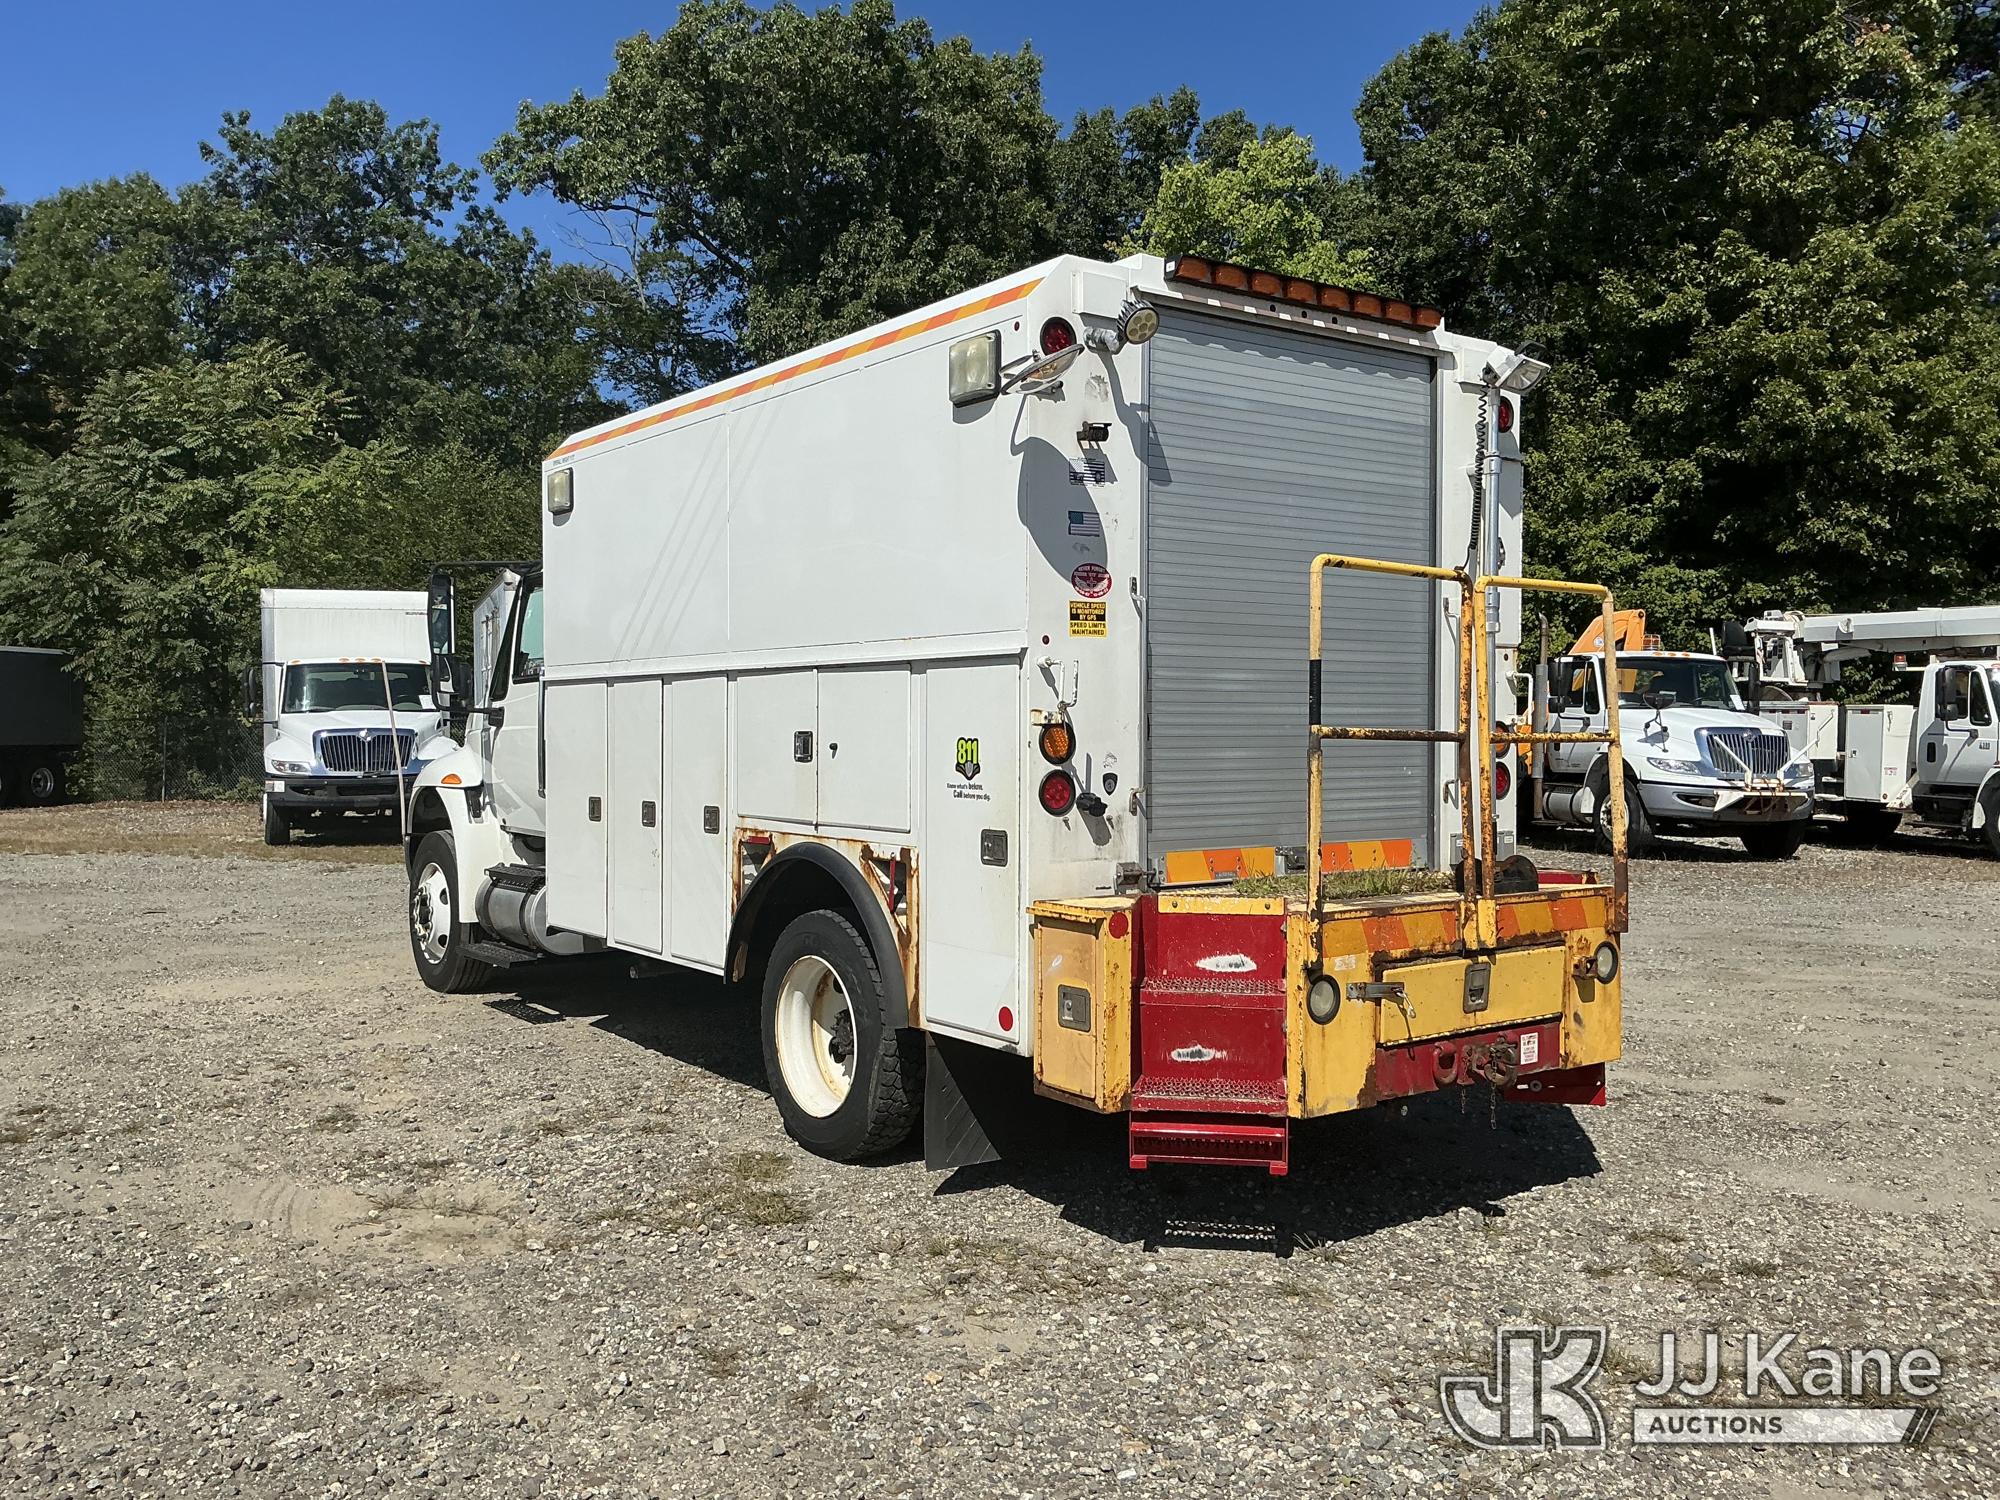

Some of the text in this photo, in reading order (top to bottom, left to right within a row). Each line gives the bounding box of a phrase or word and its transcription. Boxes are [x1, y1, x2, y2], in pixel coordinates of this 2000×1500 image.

[957, 737, 979, 765] 811
[953, 790, 963, 799] Call
[964, 792, 976, 800] before
